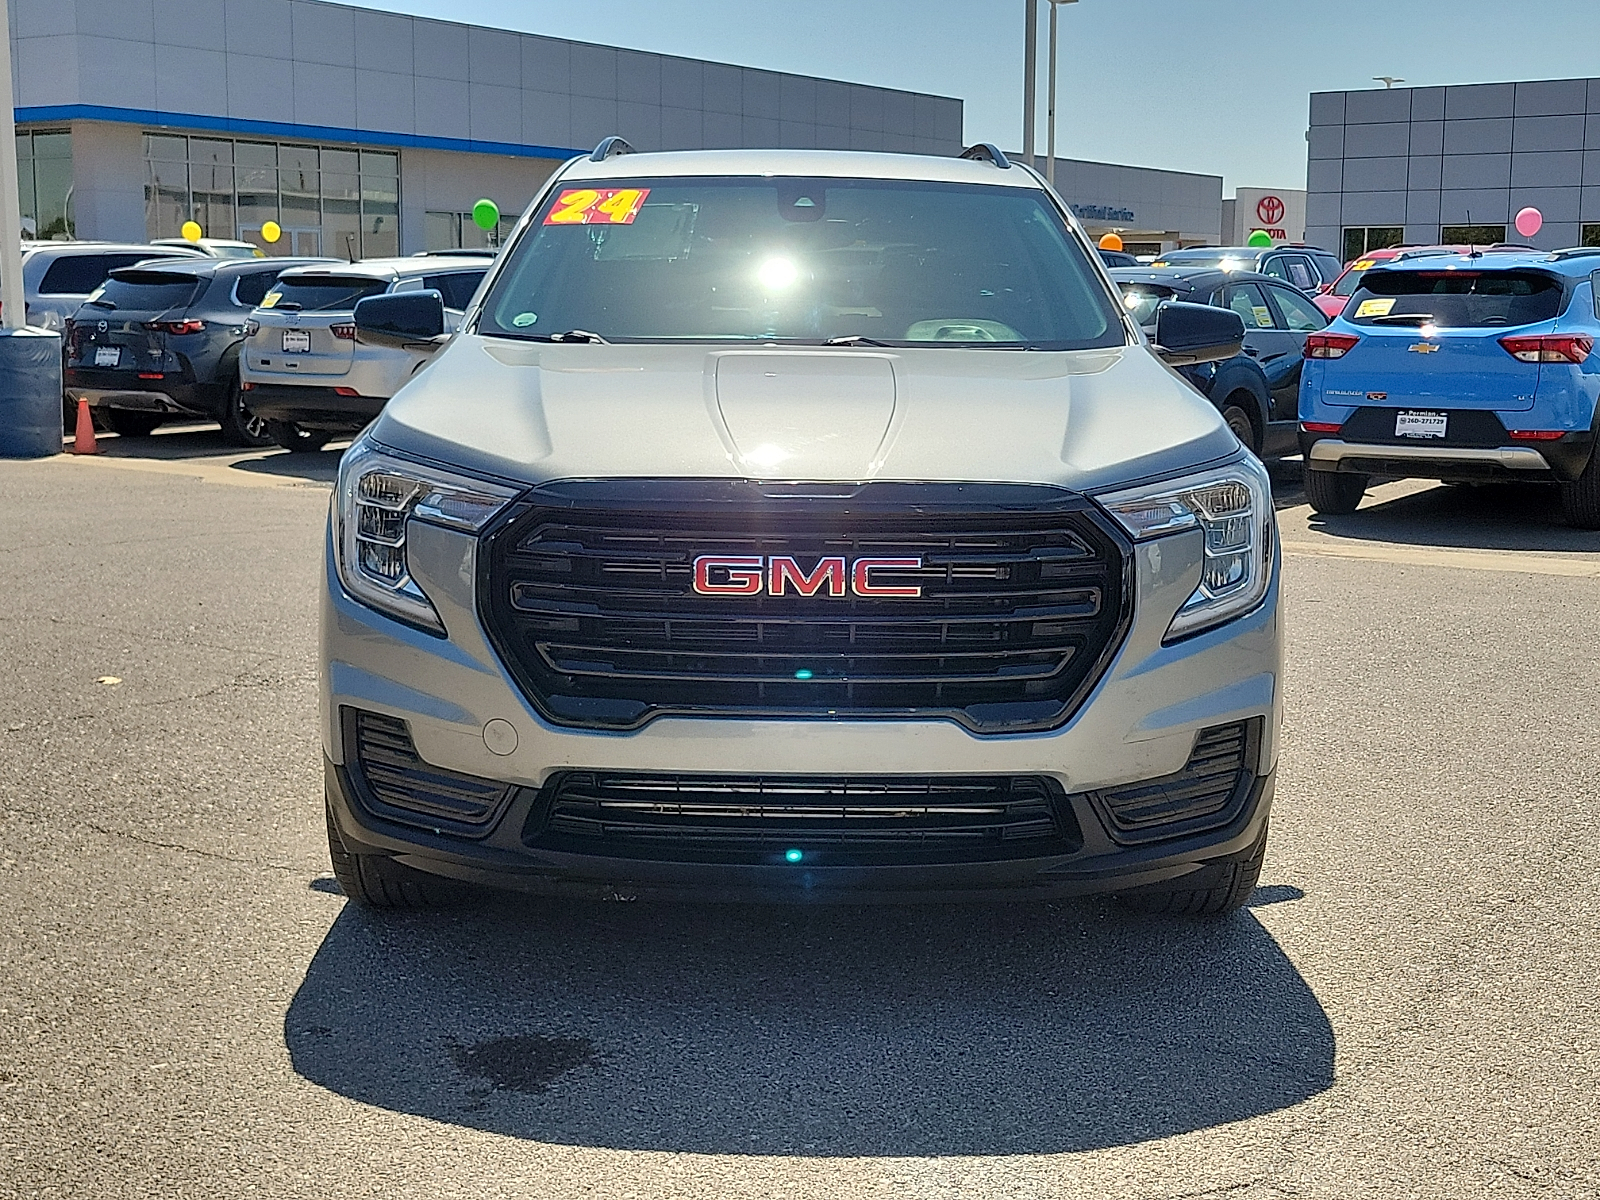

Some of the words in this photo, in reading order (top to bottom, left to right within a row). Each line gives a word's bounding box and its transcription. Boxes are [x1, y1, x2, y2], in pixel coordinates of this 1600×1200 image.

[551, 189, 642, 223] 24
[1108, 207, 1135, 222] Service
[1250, 227, 1287, 240] OTA
[692, 555, 922, 598] GMC
